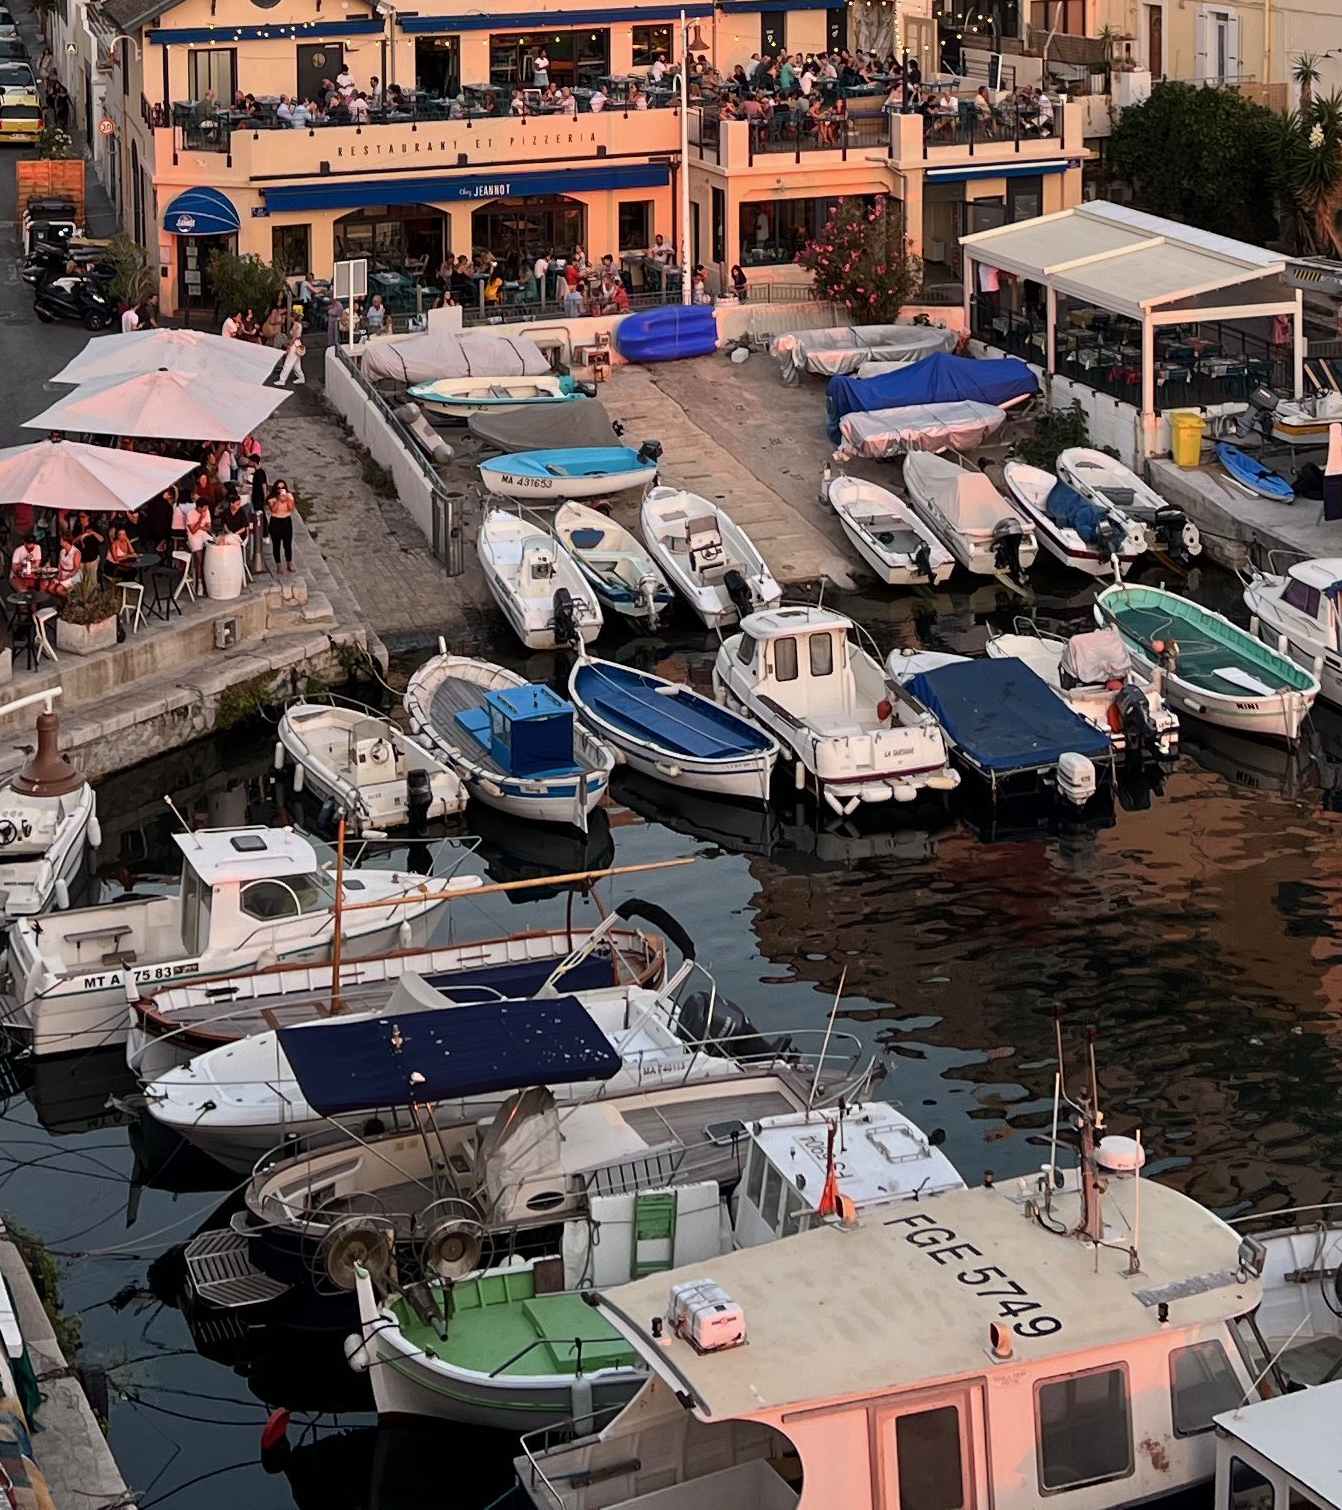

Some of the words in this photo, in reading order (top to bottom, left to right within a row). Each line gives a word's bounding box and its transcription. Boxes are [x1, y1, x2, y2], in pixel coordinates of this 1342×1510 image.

[338, 140, 458, 157] RESTAURANT
[476, 138, 493, 149] ET
[510, 132, 596, 147] PIZZERIA
[473, 183, 511, 196] JEANNOT
[501, 475, 513, 484] MA
[517, 477, 553, 489] 431653
[84, 976, 105, 988] MT
[883, 1214, 983, 1265] FGE
[956, 1266, 1062, 1337] 5749
